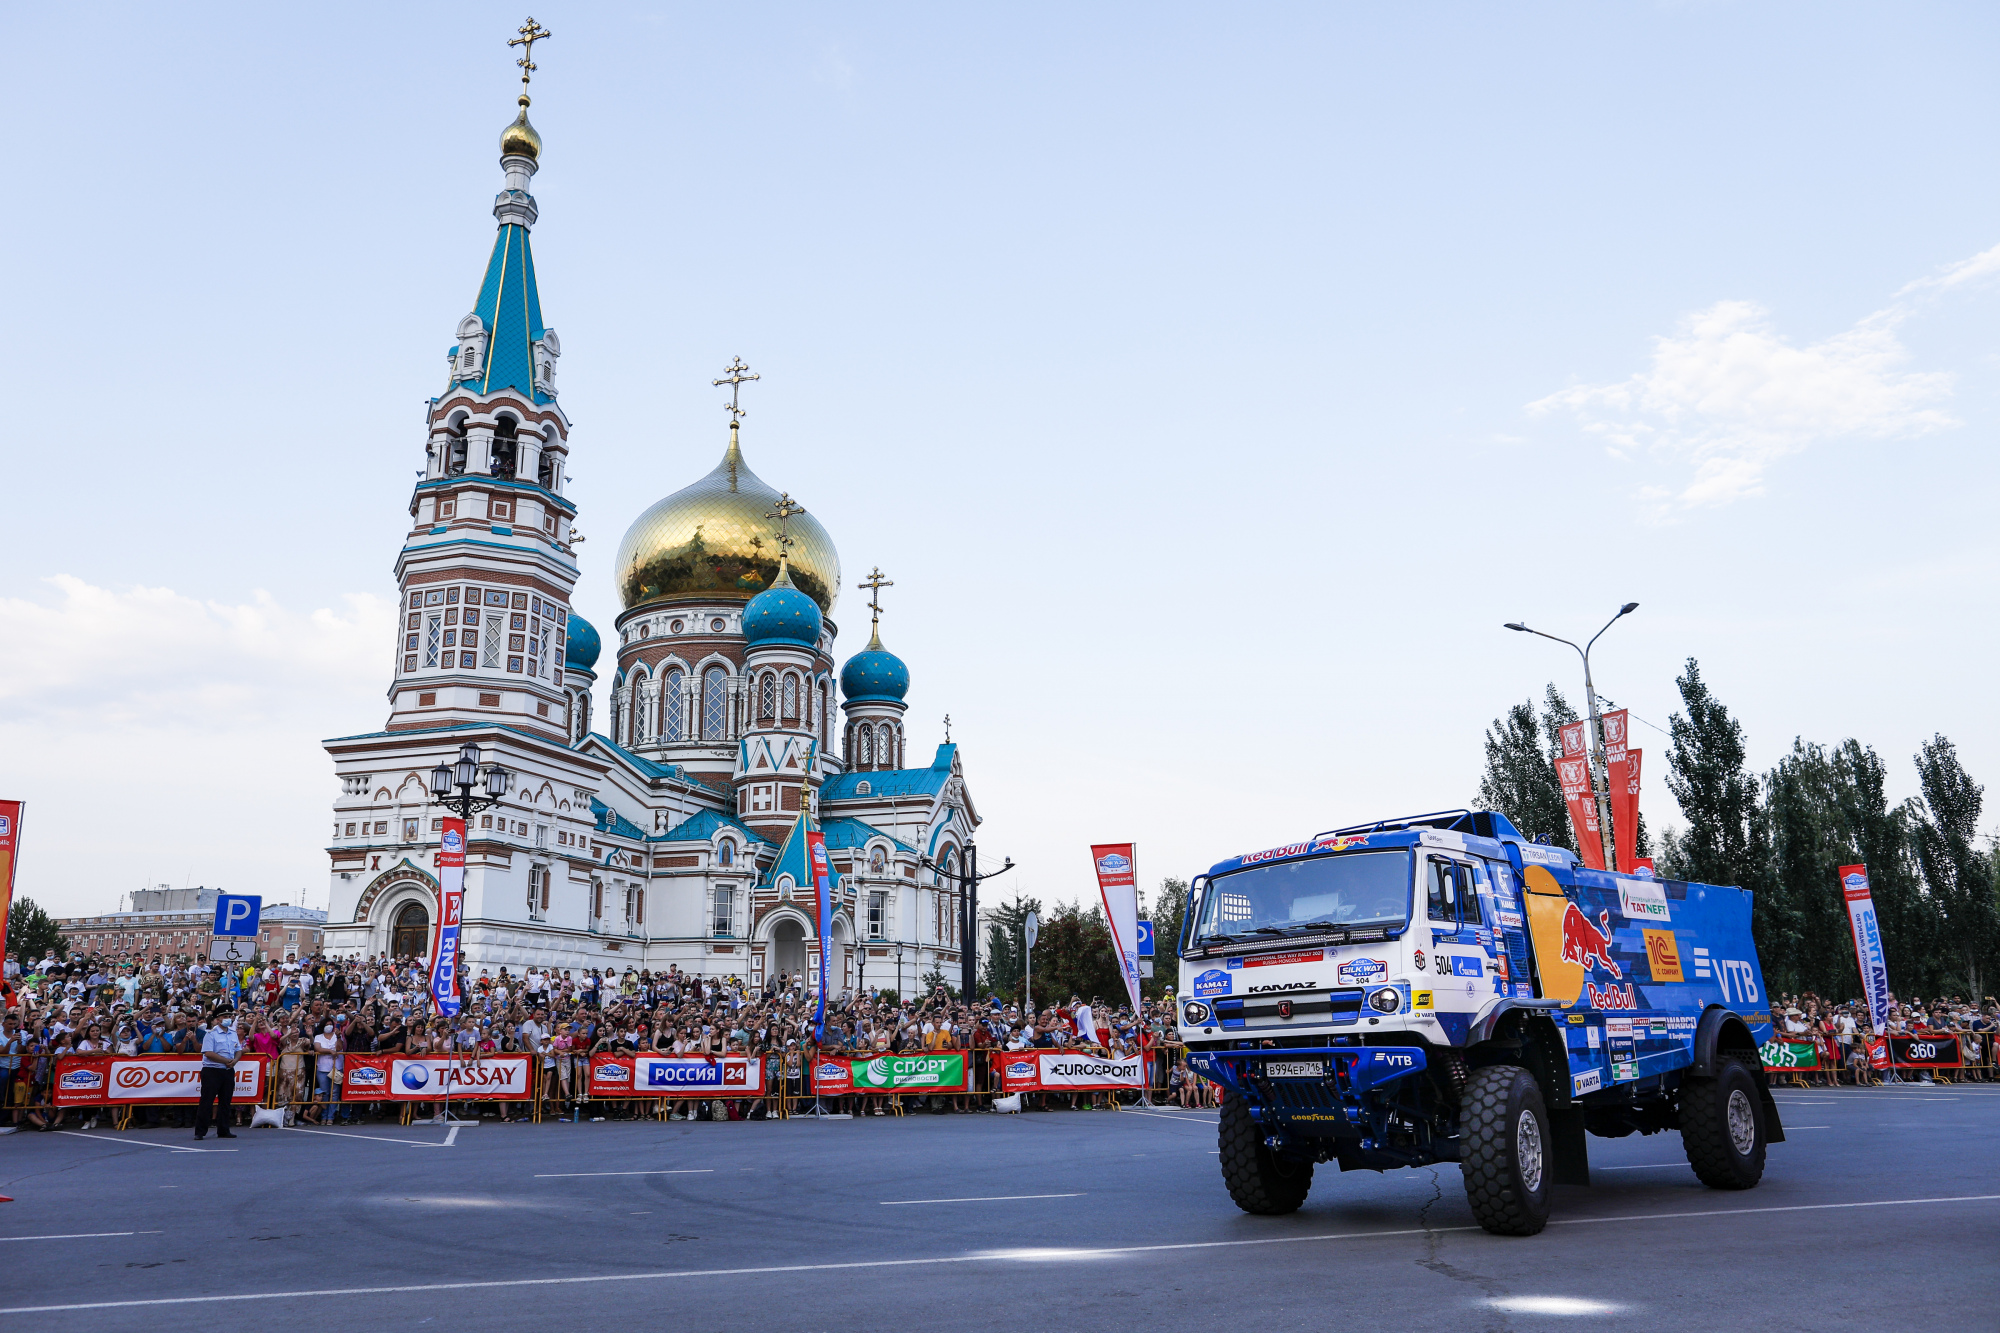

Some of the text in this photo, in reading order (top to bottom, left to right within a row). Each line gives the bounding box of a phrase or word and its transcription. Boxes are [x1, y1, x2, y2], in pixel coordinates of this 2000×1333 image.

[1606, 744, 1626, 755] SILK
[1607, 752, 1627, 764] WAY
[1564, 785, 1587, 794] SILK
[1242, 841, 1311, 865] Red Bull
[225, 899, 251, 931] P
[1631, 902, 1667, 915] TATNEFT
[1244, 955, 1277, 963] INTERNATIONAL
[1435, 955, 1453, 976] 504
[1341, 966, 1363, 974] SILK
[1363, 964, 1383, 972] WAY
[1196, 980, 1229, 990] KAMAZ
[1248, 981, 1317, 993] KAMAZ
[1712, 958, 1759, 1003] VTB
[1203, 987, 1223, 995] master
[1587, 983, 1637, 1009] Red Bull
[1666, 1016, 1697, 1030] WABCO
[1740, 1011, 1771, 1027] OODYEAR
[1908, 1042, 1936, 1059] 360
[893, 1059, 948, 1073] СПОРТ
[1197, 1059, 1210, 1070] VTB
[1386, 1055, 1413, 1066] VTB
[655, 1067, 745, 1081] РОССИЯ 24
[1055, 1063, 1138, 1077] EUROSPORT
[1270, 1062, 1320, 1075] В994ЕР 716
[434, 1067, 517, 1086] TASSAY
[1581, 1075, 1600, 1088] VARTA
[1291, 1113, 1335, 1122] GOODYEAR
